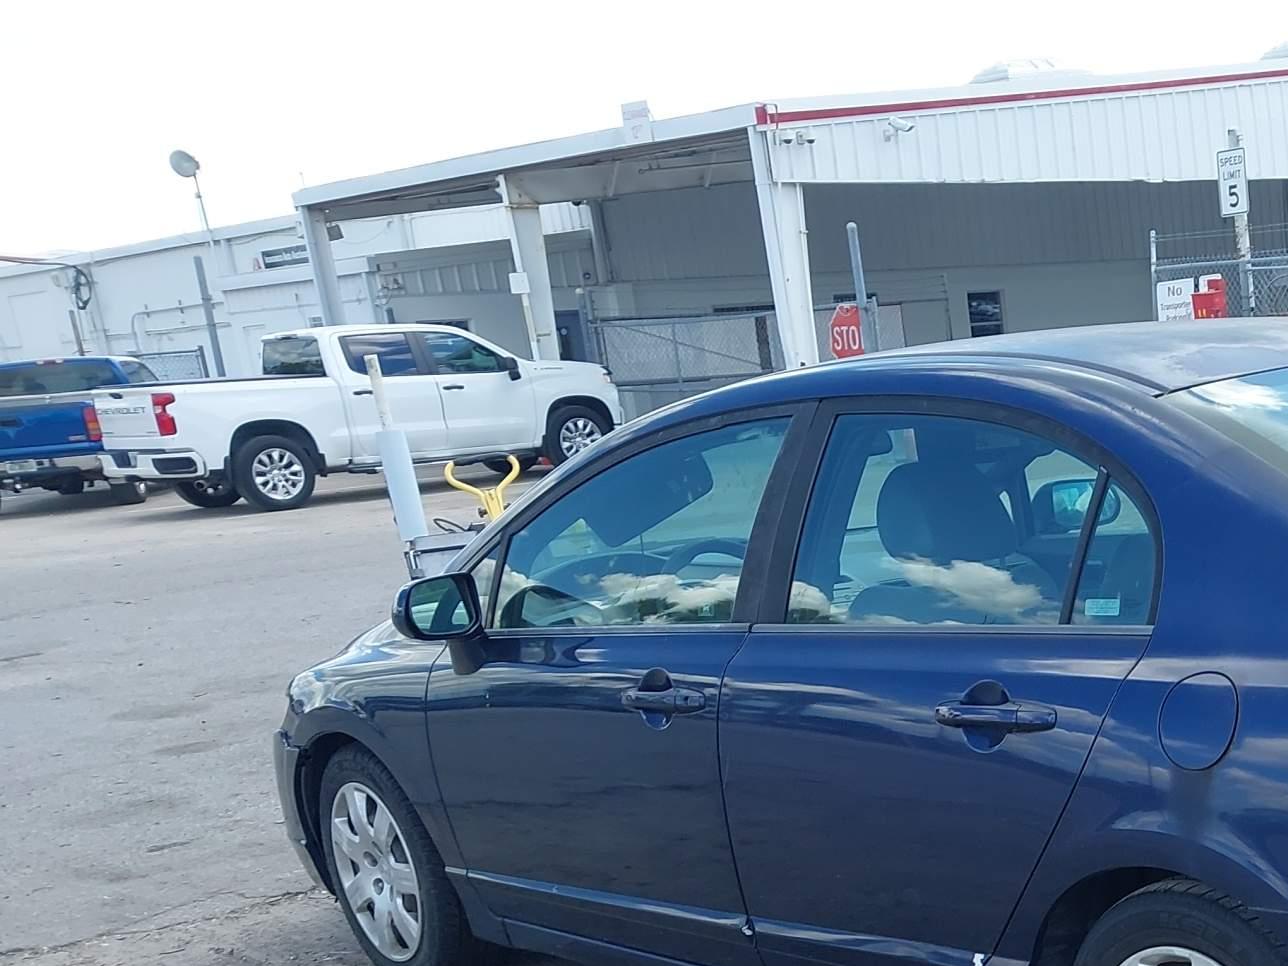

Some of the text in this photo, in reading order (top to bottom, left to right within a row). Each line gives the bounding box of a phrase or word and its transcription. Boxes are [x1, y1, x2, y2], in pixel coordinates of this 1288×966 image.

[1220, 155, 1243, 167] SPEED
[1223, 169, 1241, 181] LIMIT
[1229, 184, 1239, 208] 5
[1167, 285, 1182, 297] No
[833, 325, 865, 350] STO
